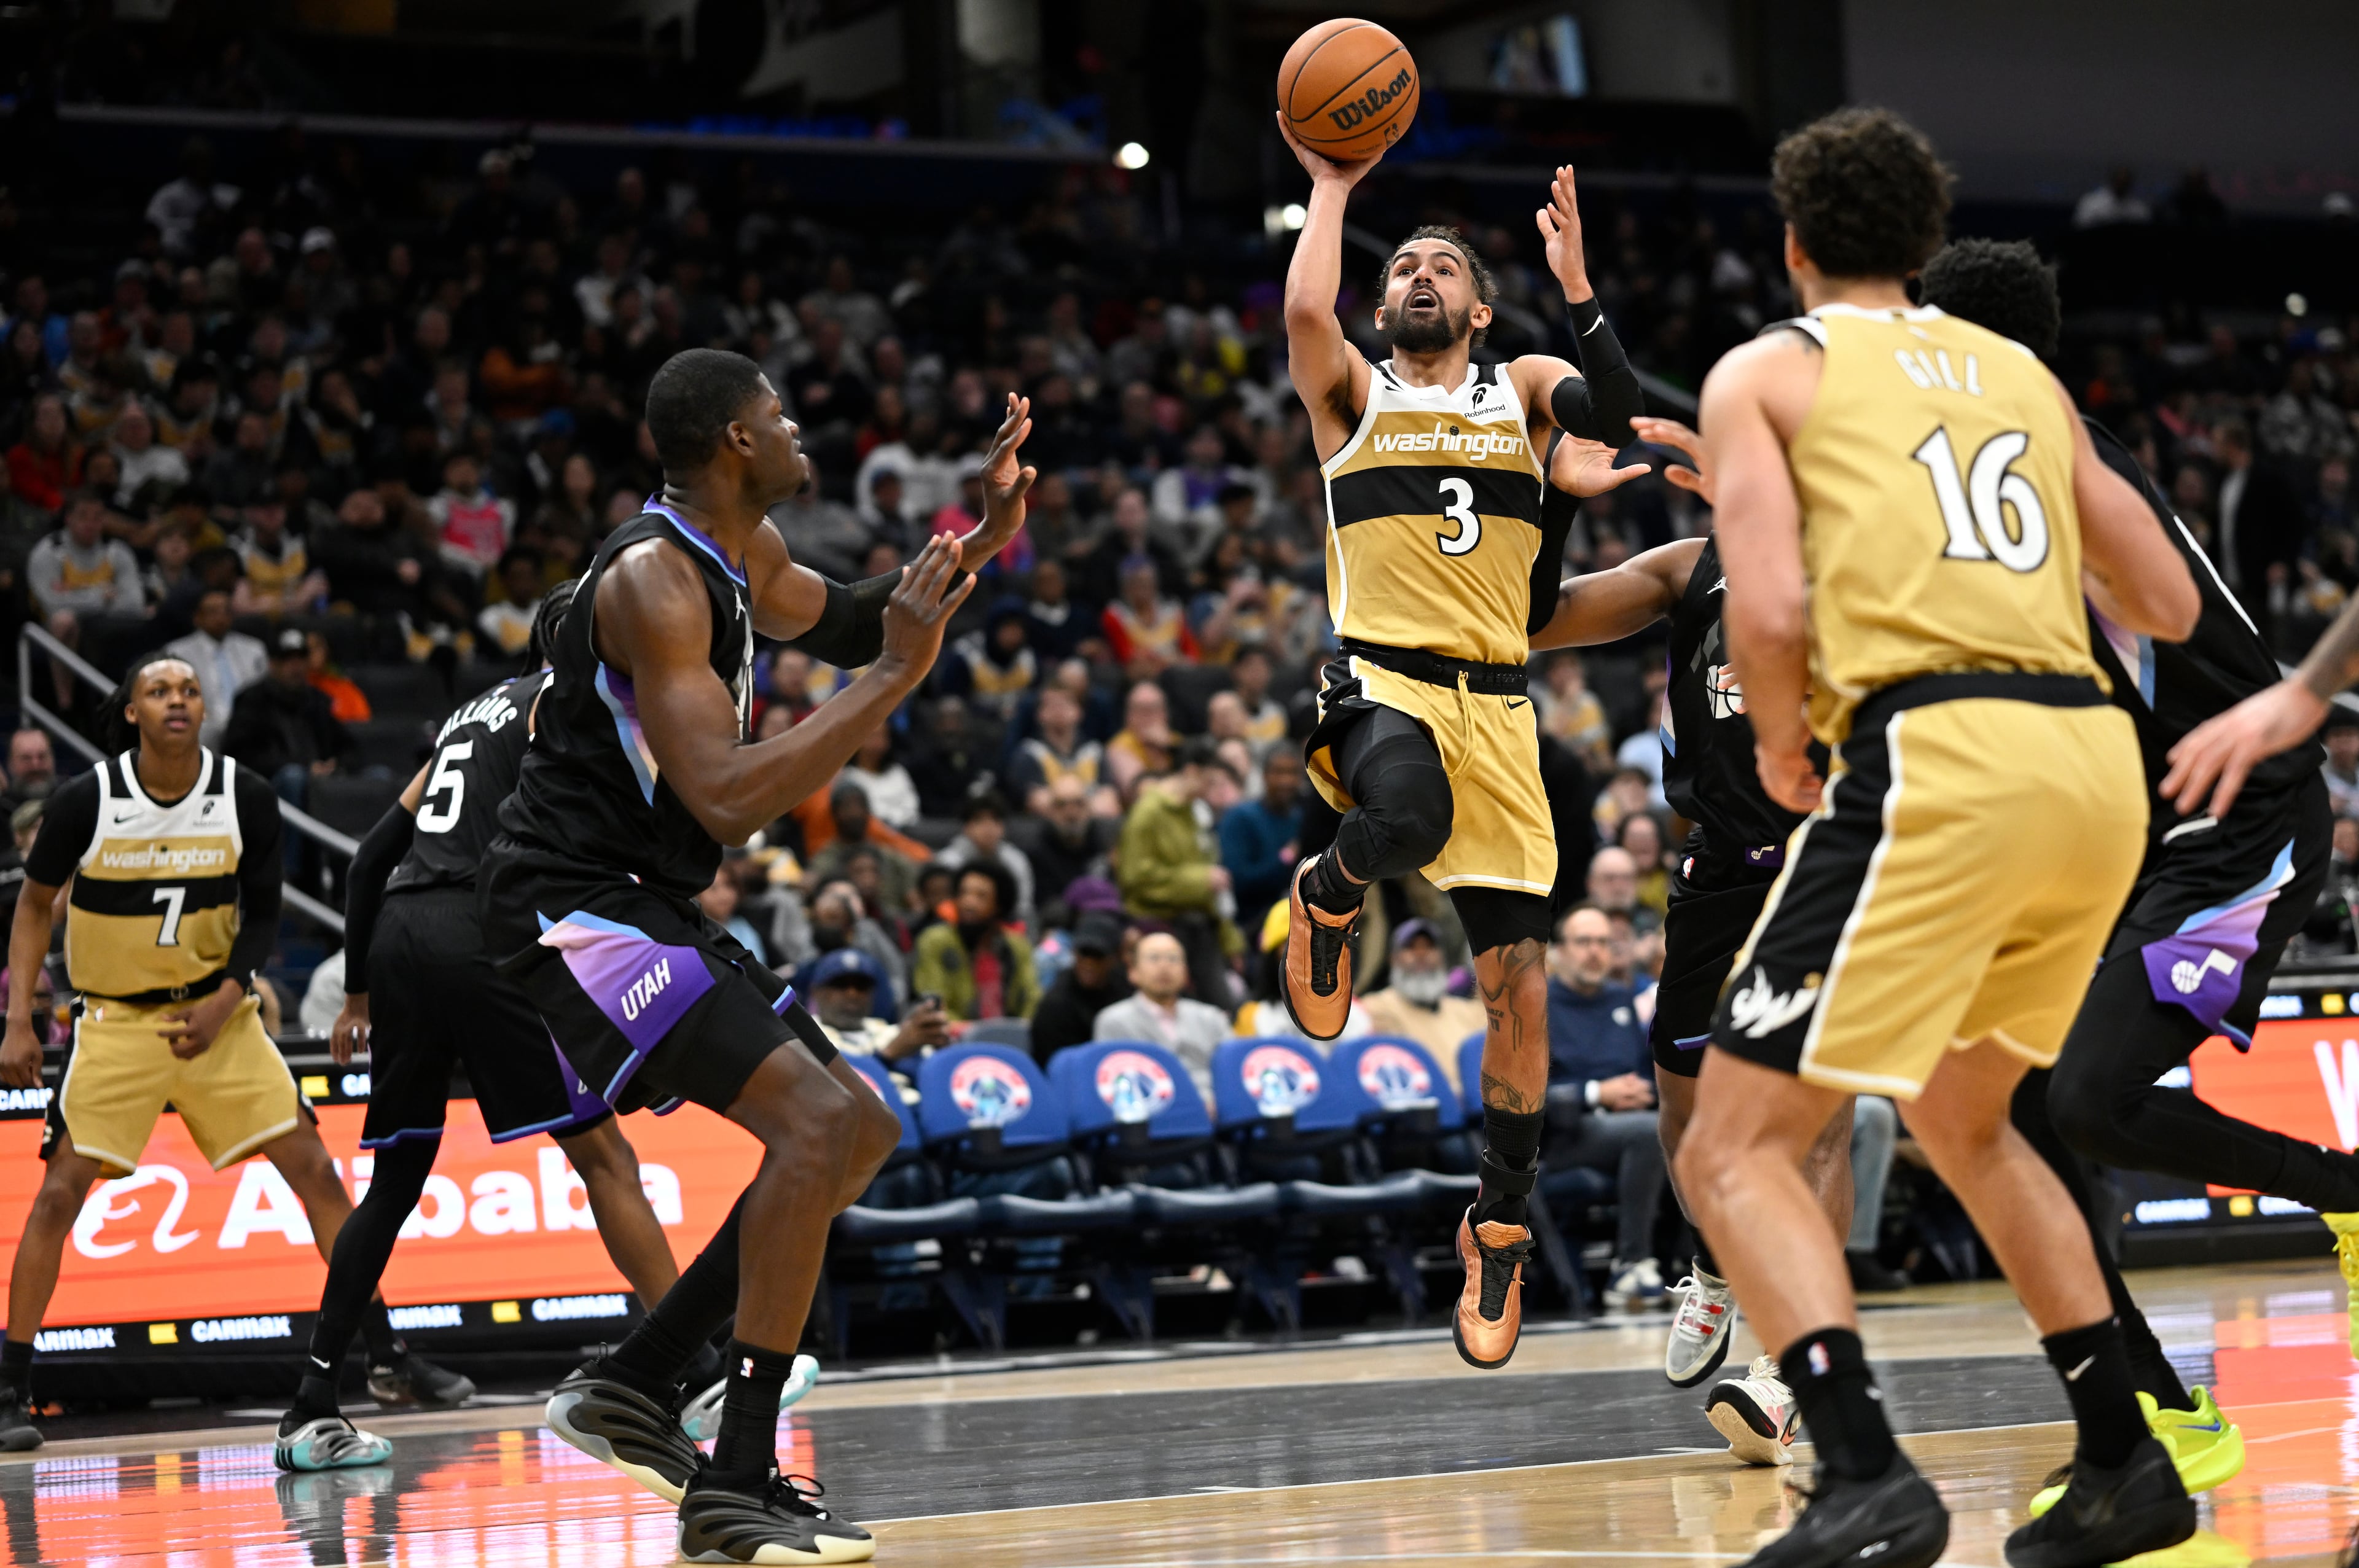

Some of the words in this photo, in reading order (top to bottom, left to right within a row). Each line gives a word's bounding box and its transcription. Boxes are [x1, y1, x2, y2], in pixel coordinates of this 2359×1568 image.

[1328, 68, 1412, 130] Wilson
[1893, 348, 1984, 397] GILL
[1374, 421, 1524, 461] washington
[1464, 404, 1506, 418] Robinhood
[1436, 475, 1482, 556] 3
[1911, 425, 2049, 574] 16
[417, 739, 473, 833] 5
[103, 844, 225, 873] washington
[152, 886, 186, 946] 7
[621, 958, 671, 1021] UTAH
